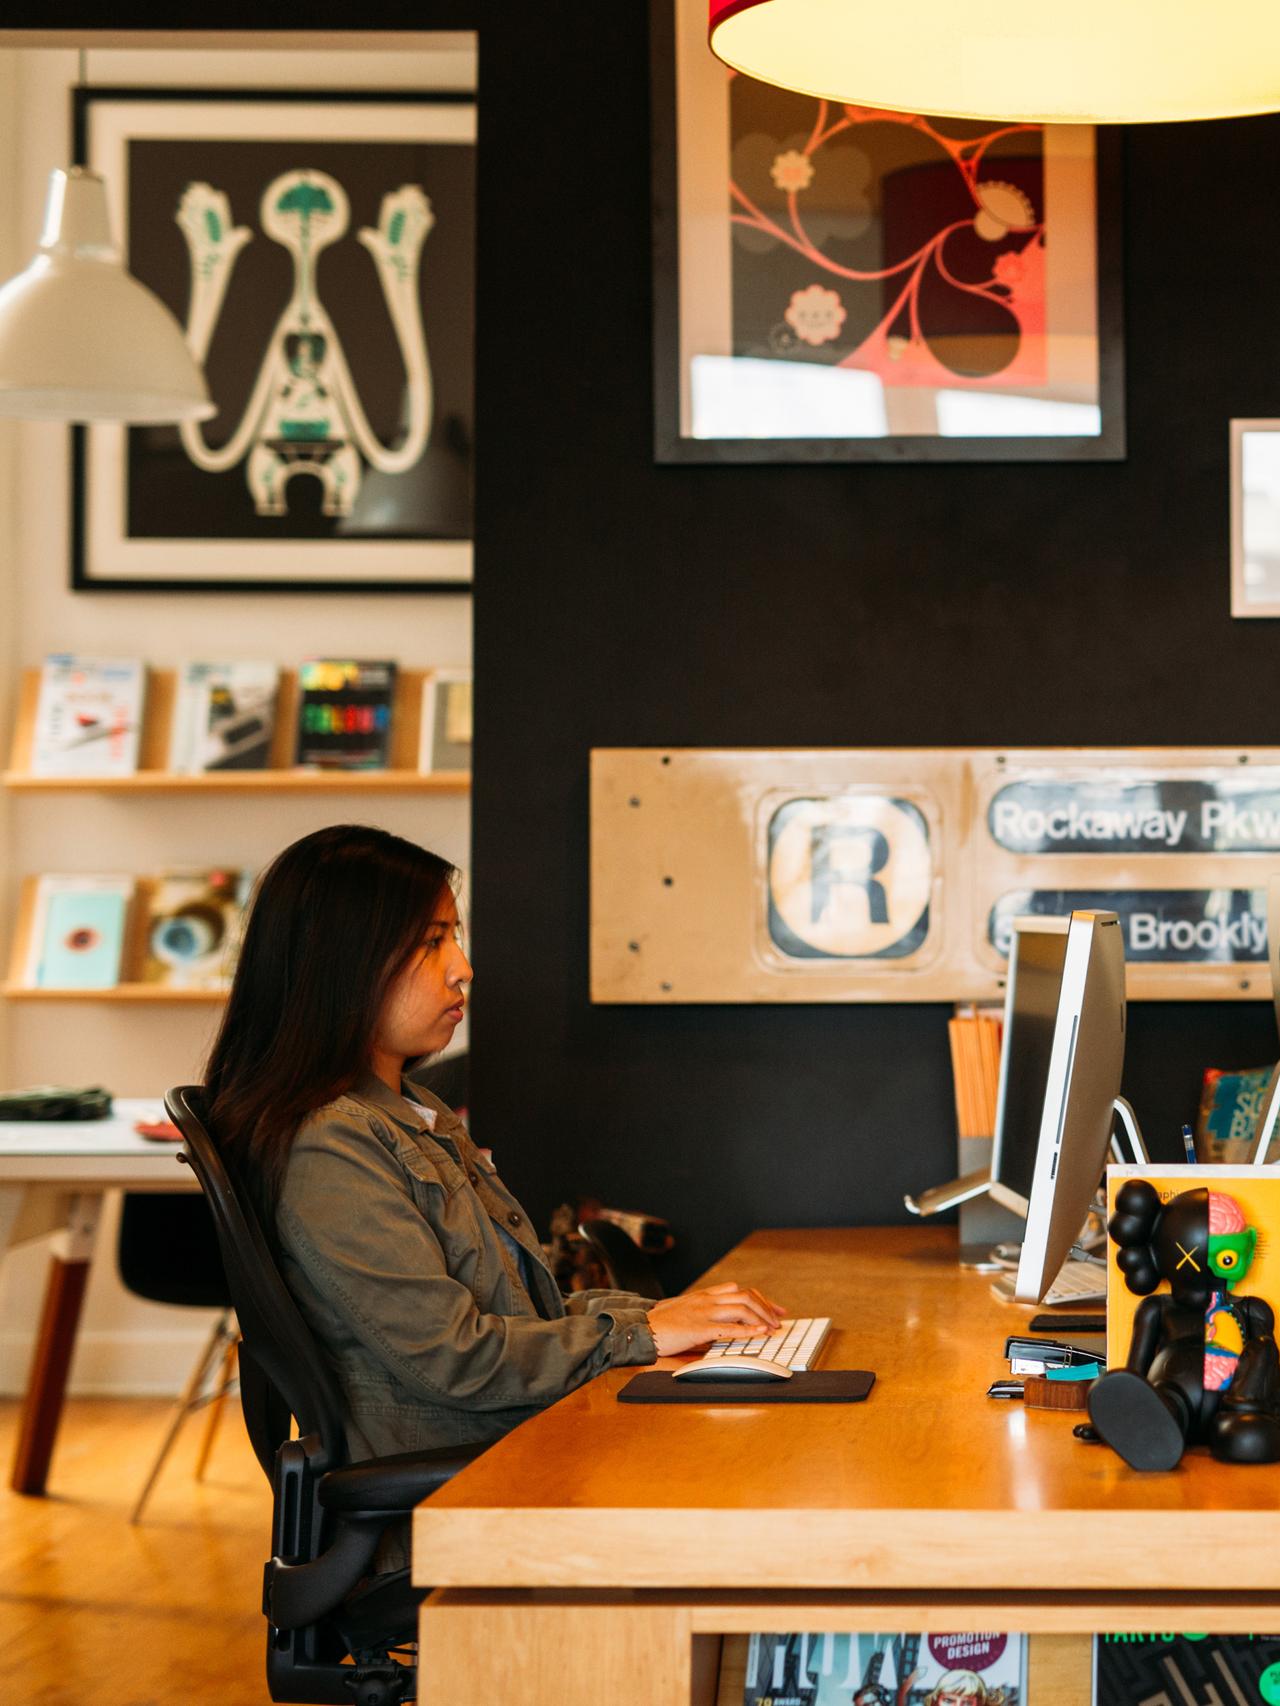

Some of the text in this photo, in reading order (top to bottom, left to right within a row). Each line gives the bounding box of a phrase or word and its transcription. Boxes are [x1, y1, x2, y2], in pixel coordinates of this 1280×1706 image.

[992, 800, 1187, 846] Rockaway
[810, 823, 890, 924] R
[1129, 911, 1268, 961] Brookly
[947, 1641, 991, 1660] DESIGN
